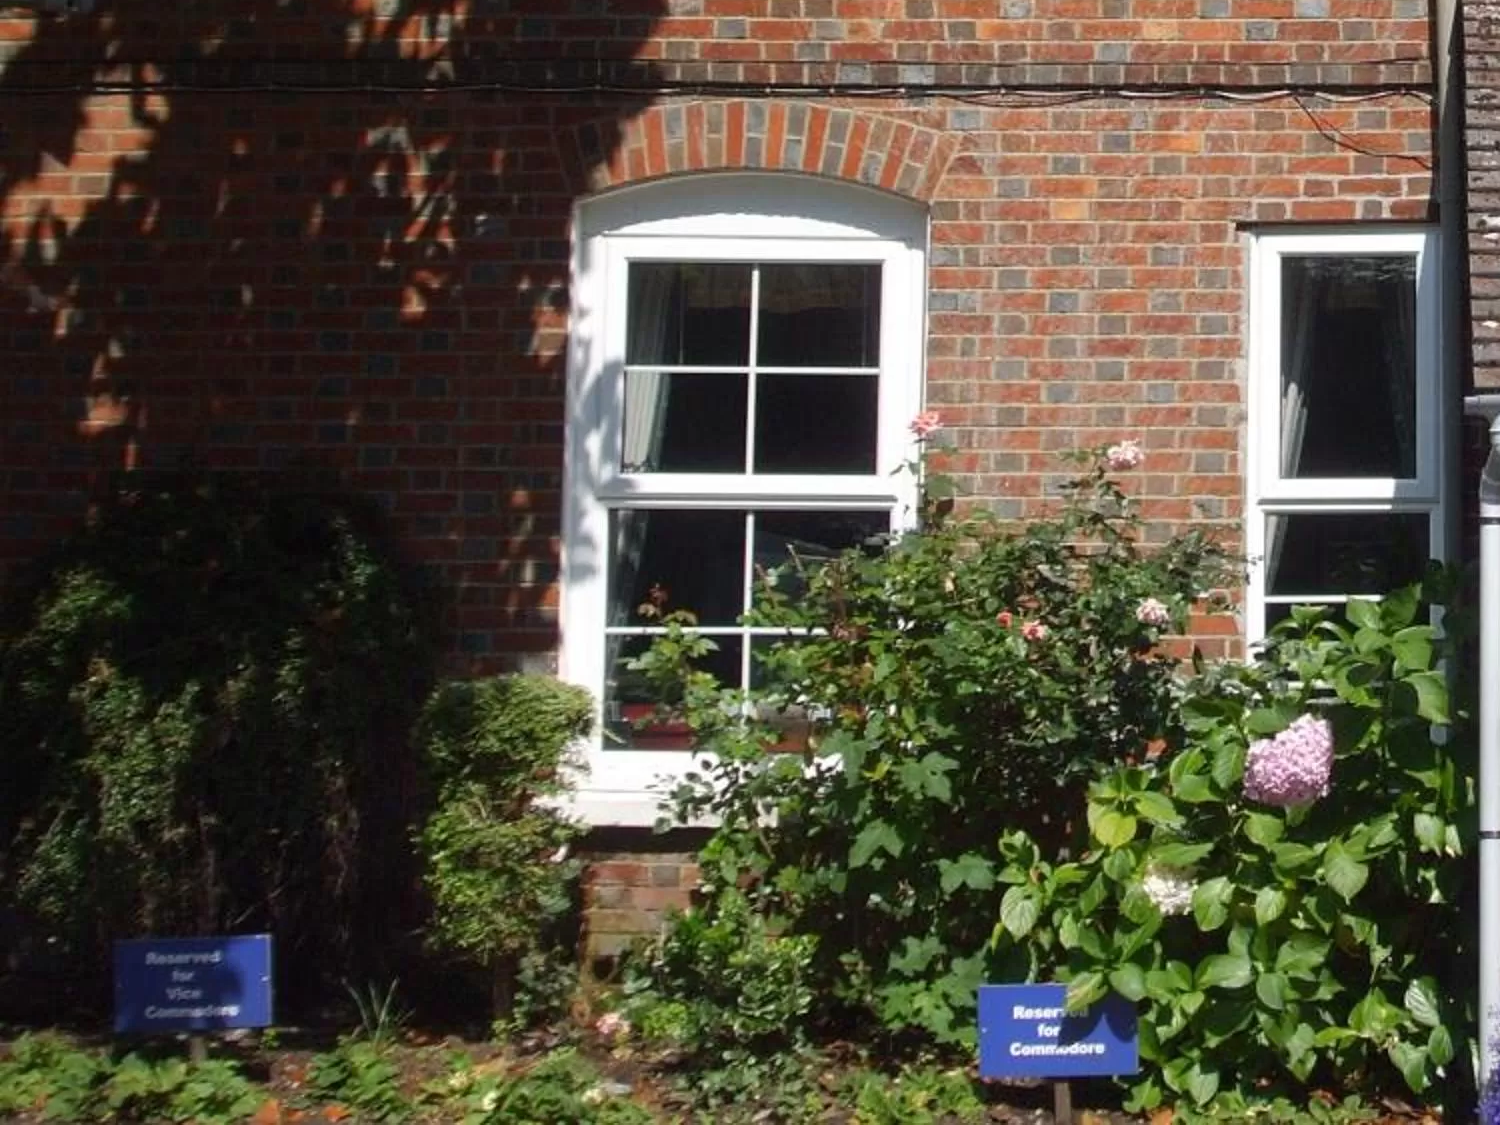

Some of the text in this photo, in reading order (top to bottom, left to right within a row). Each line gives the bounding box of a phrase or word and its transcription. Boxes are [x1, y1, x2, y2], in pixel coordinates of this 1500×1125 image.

[145, 950, 223, 965] Reserved
[172, 970, 195, 982] for
[165, 987, 203, 1000] Vice
[1037, 1023, 1061, 1038] for
[1010, 1042, 1106, 1056] Commodore
